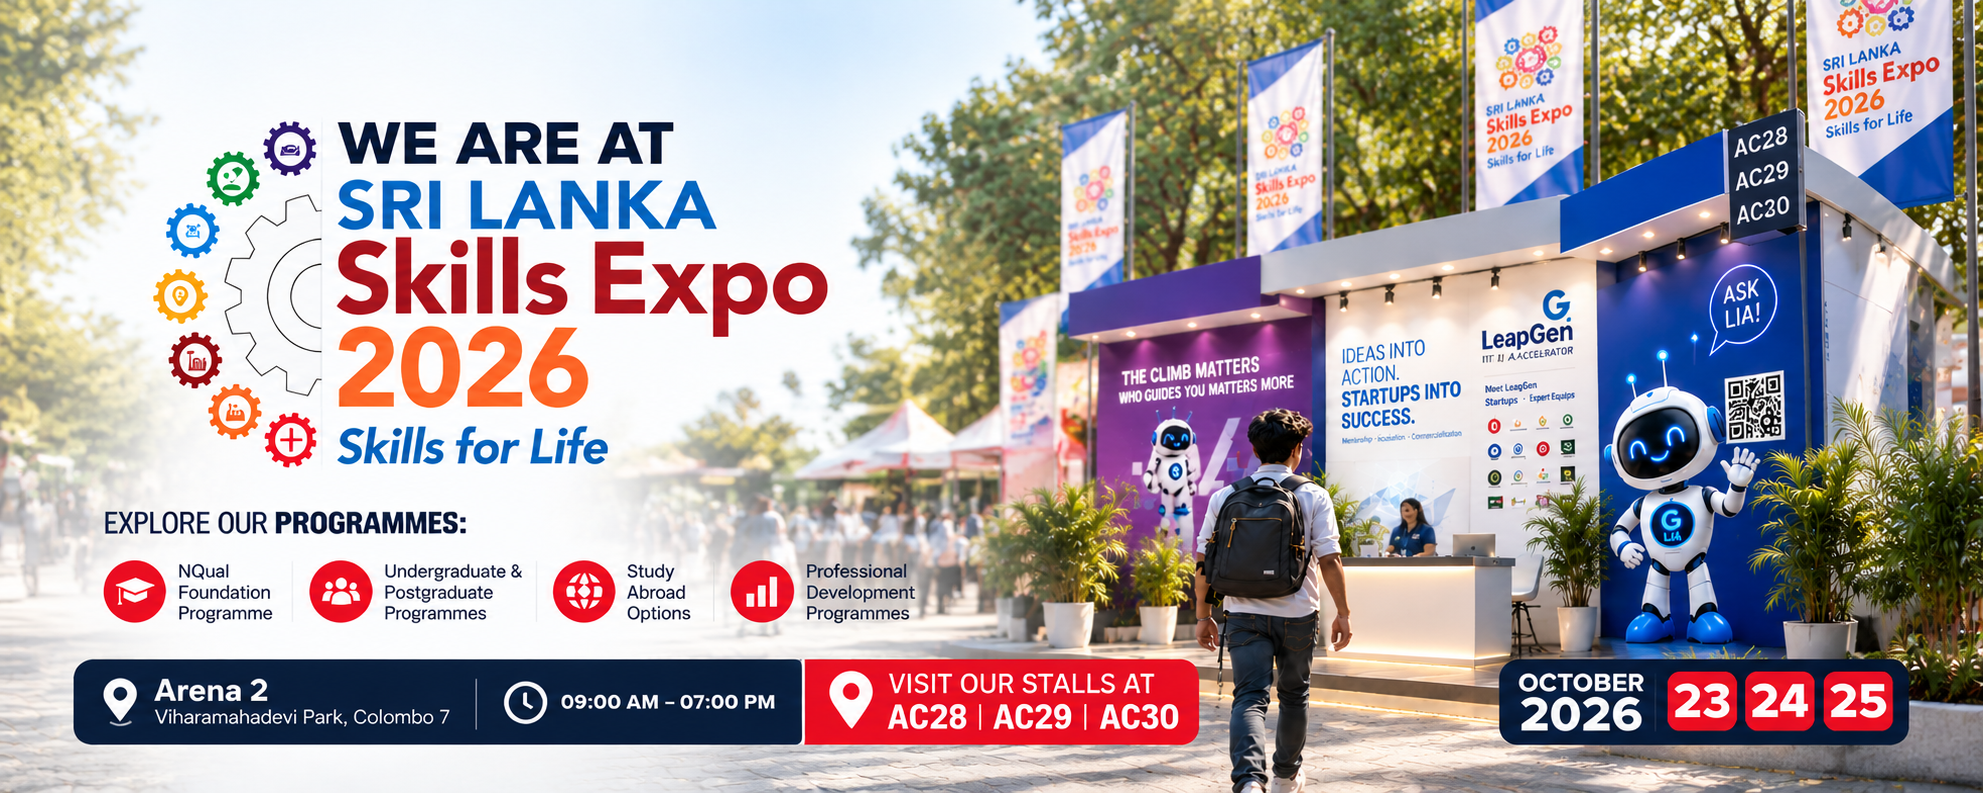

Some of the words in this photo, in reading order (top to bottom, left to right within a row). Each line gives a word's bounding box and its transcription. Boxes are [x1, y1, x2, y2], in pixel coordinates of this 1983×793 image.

[1823, 55, 1845, 71] SRI
[1849, 41, 1901, 66] LANKA
[1823, 67, 1877, 96] Skills
[1883, 57, 1940, 82] Expo
[1486, 103, 1504, 116] SRI
[1824, 88, 1885, 121] 2026
[1486, 112, 1527, 135] Skills
[1531, 104, 1573, 125] Expo
[1826, 121, 1860, 139] Skills
[1863, 117, 1883, 131] for
[1888, 109, 1913, 126] Life
[1487, 129, 1533, 154] 2026
[1734, 126, 1788, 158] AC28
[1517, 150, 1532, 162] for
[1255, 177, 1284, 195] Skills
[1287, 174, 1316, 189] Expo
[1735, 160, 1789, 191] AC29
[1723, 278, 1759, 305] ASK
[1725, 302, 1760, 329] LIA!
[1481, 323, 1573, 350] LeapGen
[1342, 344, 1385, 364] IDEAS
[1390, 339, 1425, 359] INTO
[1121, 369, 1147, 386] THE
[1150, 364, 1191, 383] CLIMB
[1195, 356, 1260, 379] MATTERS
[1342, 364, 1400, 386] ACTION.
[1119, 389, 1143, 404] WHO
[1144, 386, 1181, 402] GUIDES
[1184, 384, 1205, 398] YOU
[1208, 378, 1257, 396] MATTERS
[1261, 374, 1295, 391] MORE
[1342, 384, 1420, 408] STARTUPS
[1425, 381, 1461, 400] INTO
[1342, 407, 1415, 429] SUCCESS.
